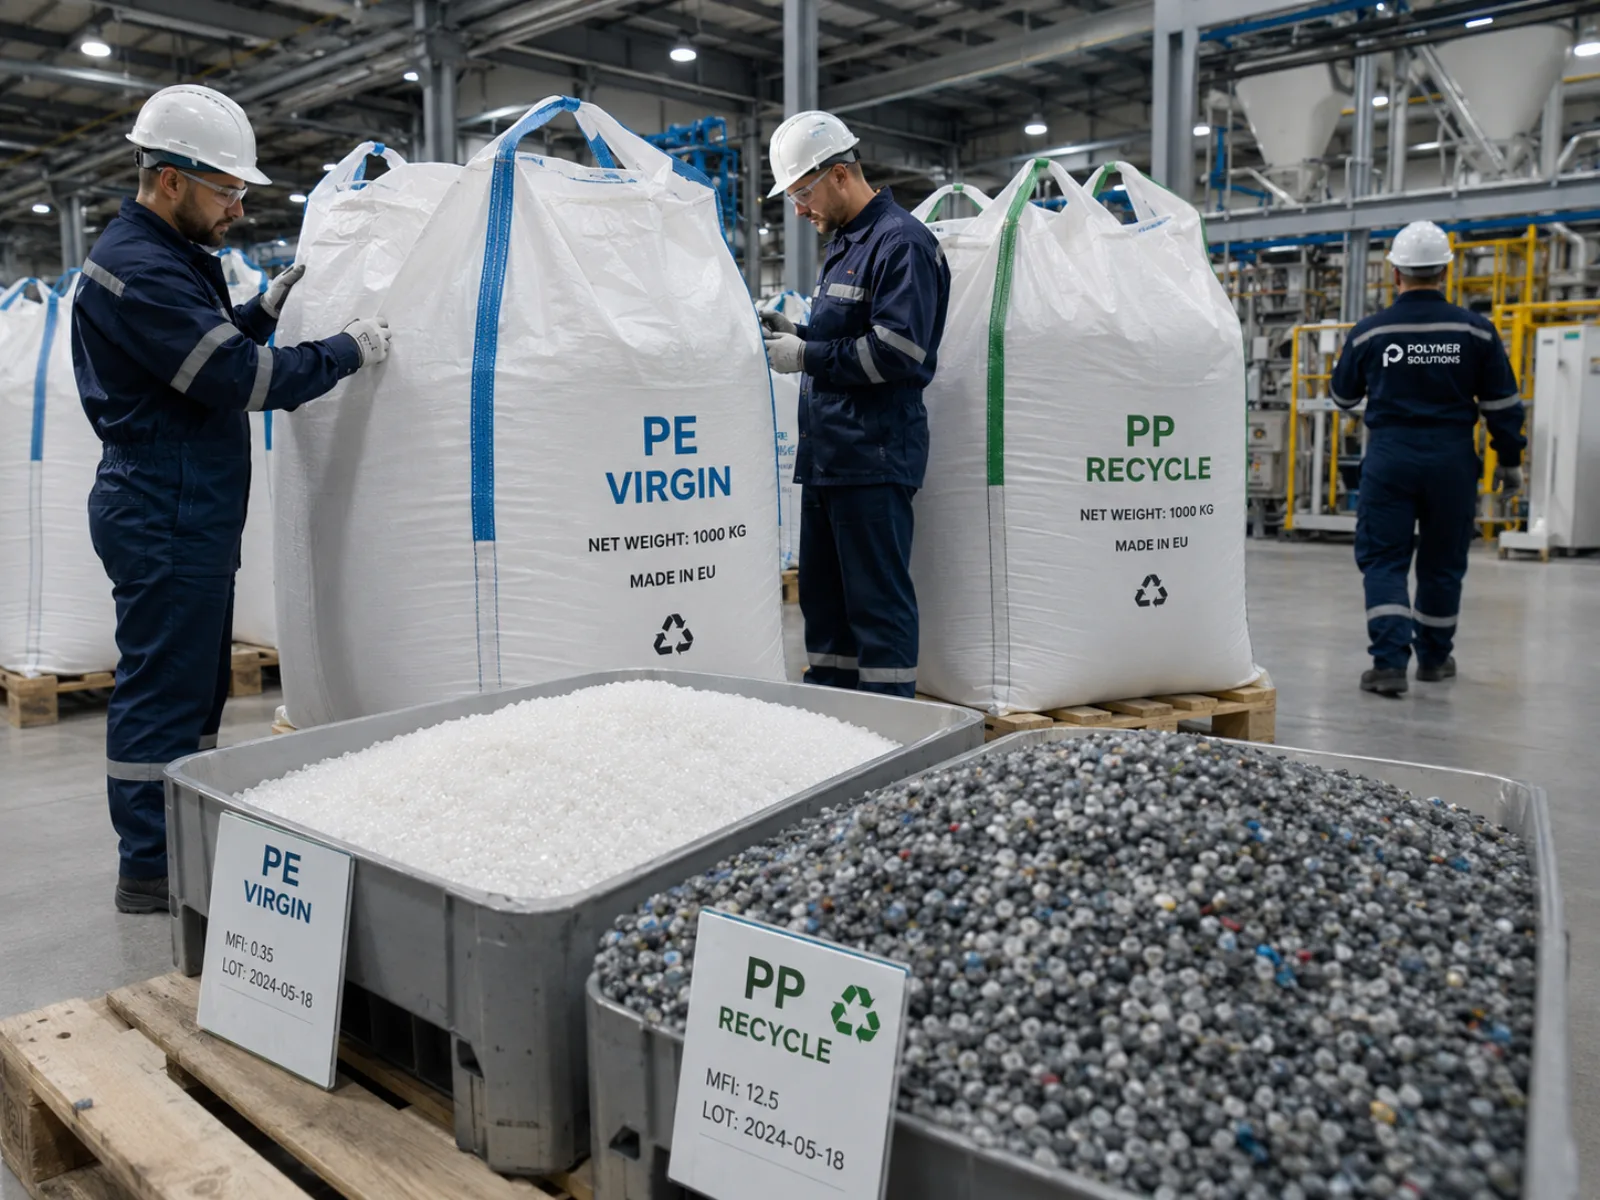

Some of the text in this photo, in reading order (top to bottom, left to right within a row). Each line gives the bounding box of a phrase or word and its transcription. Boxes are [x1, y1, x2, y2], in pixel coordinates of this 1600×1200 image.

[1408, 344, 1460, 354] POLYMER
[1408, 356, 1460, 364] SOLUTIONS
[643, 416, 697, 456] PE
[1127, 415, 1174, 447] PP
[606, 466, 730, 504] VIRGIN
[1087, 456, 1210, 482] RECYCLE
[1080, 504, 1213, 521] NET WEIGHT: 1000 KG
[589, 524, 746, 552] NET WEIGHT: 1000 KG
[1116, 536, 1188, 551] MADE IN EU
[630, 565, 716, 588] MADE IN EU
[262, 844, 301, 887] PE
[244, 880, 312, 924] VIRGIN
[226, 930, 273, 963] MFI: 0.35
[222, 957, 313, 1008] LOT: 2024-05-18
[745, 956, 805, 1009] PP
[719, 1006, 832, 1064] RECYCLE
[706, 1068, 779, 1110] MFI: 12.5
[703, 1101, 844, 1170] LOT: 2024-05-18
